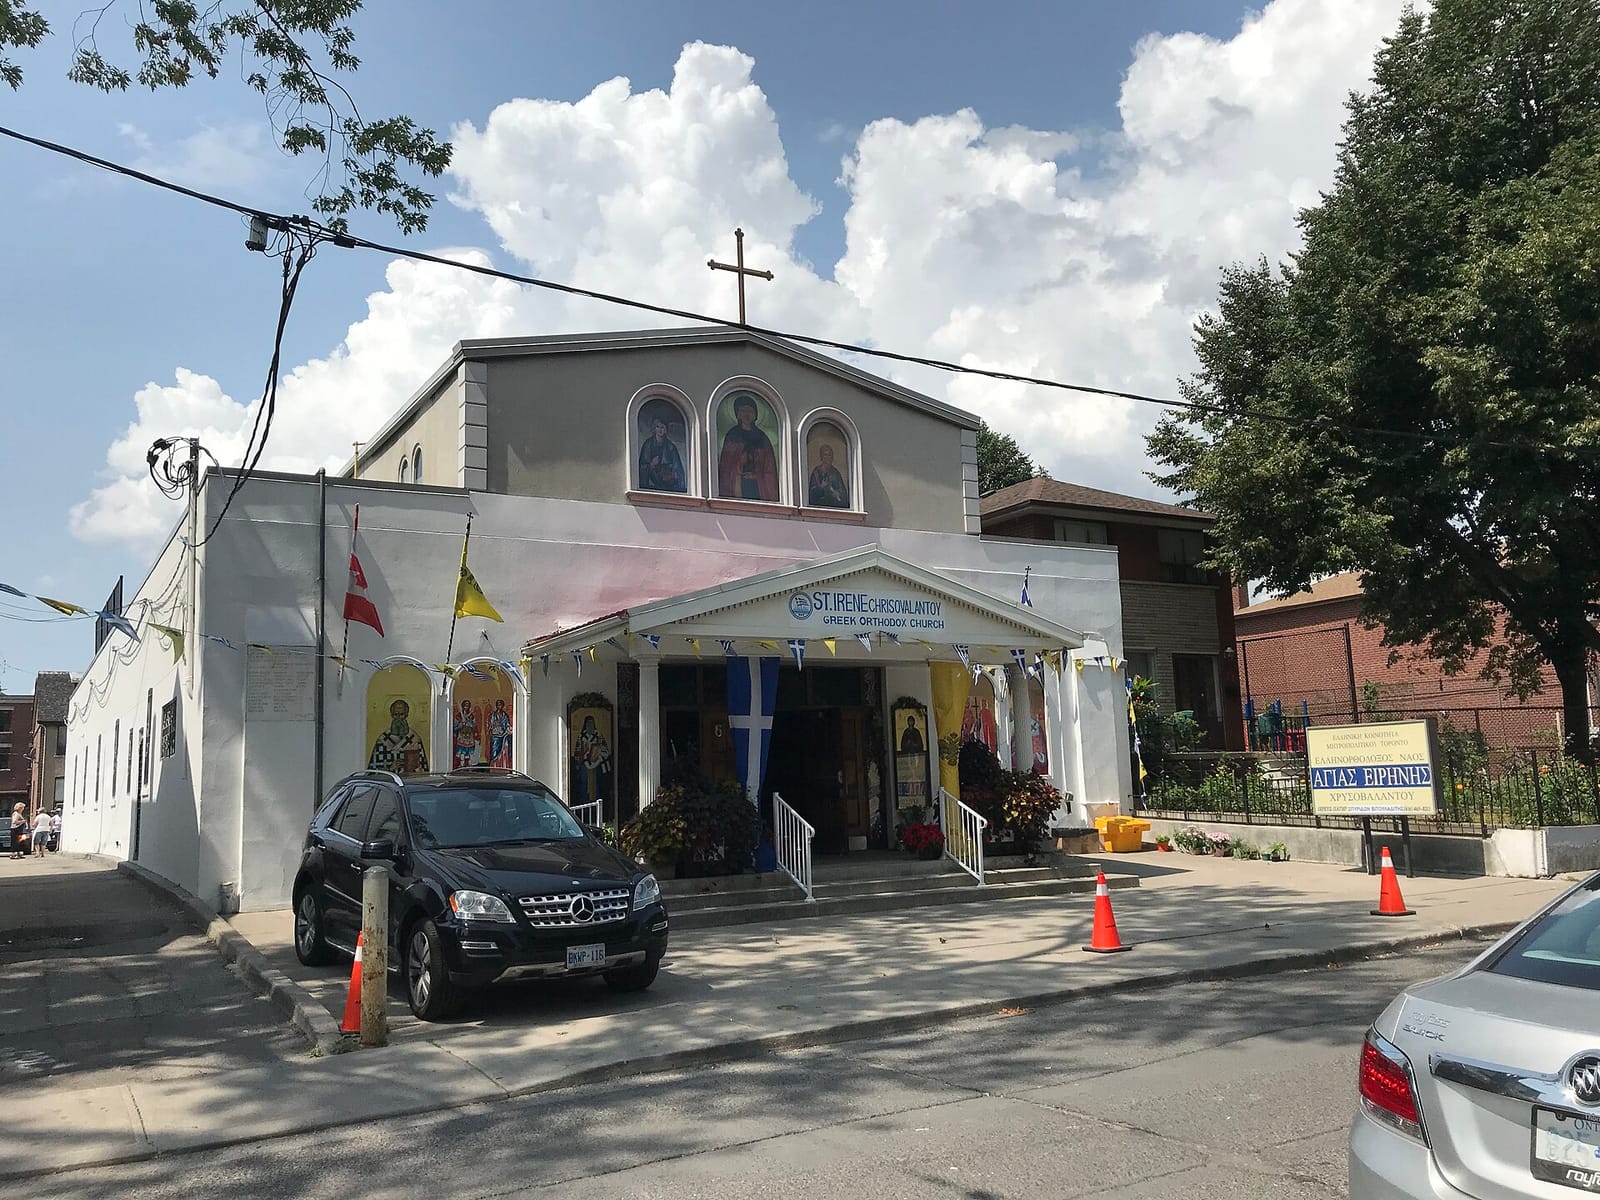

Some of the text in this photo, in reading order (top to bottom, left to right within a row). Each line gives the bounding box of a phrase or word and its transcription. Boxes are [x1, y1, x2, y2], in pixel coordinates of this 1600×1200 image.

[868, 598, 942, 617] CHRISOVALANTOY
[823, 616, 945, 629] GREEK ORTHODOX CHURCH
[1315, 753, 1425, 765] ΕΛΛΗΝΟΡΘΟΔΟΞΟΣ ΝΑΟΣ
[1313, 766, 1432, 788] ΑΓΙΑΣ ΕΙΡΗΝΗΣ
[1329, 791, 1416, 802] ΧΡΥΣΟΒΑΛΑΝΤΟΥ
[1402, 1023, 1446, 1042] BUICK
